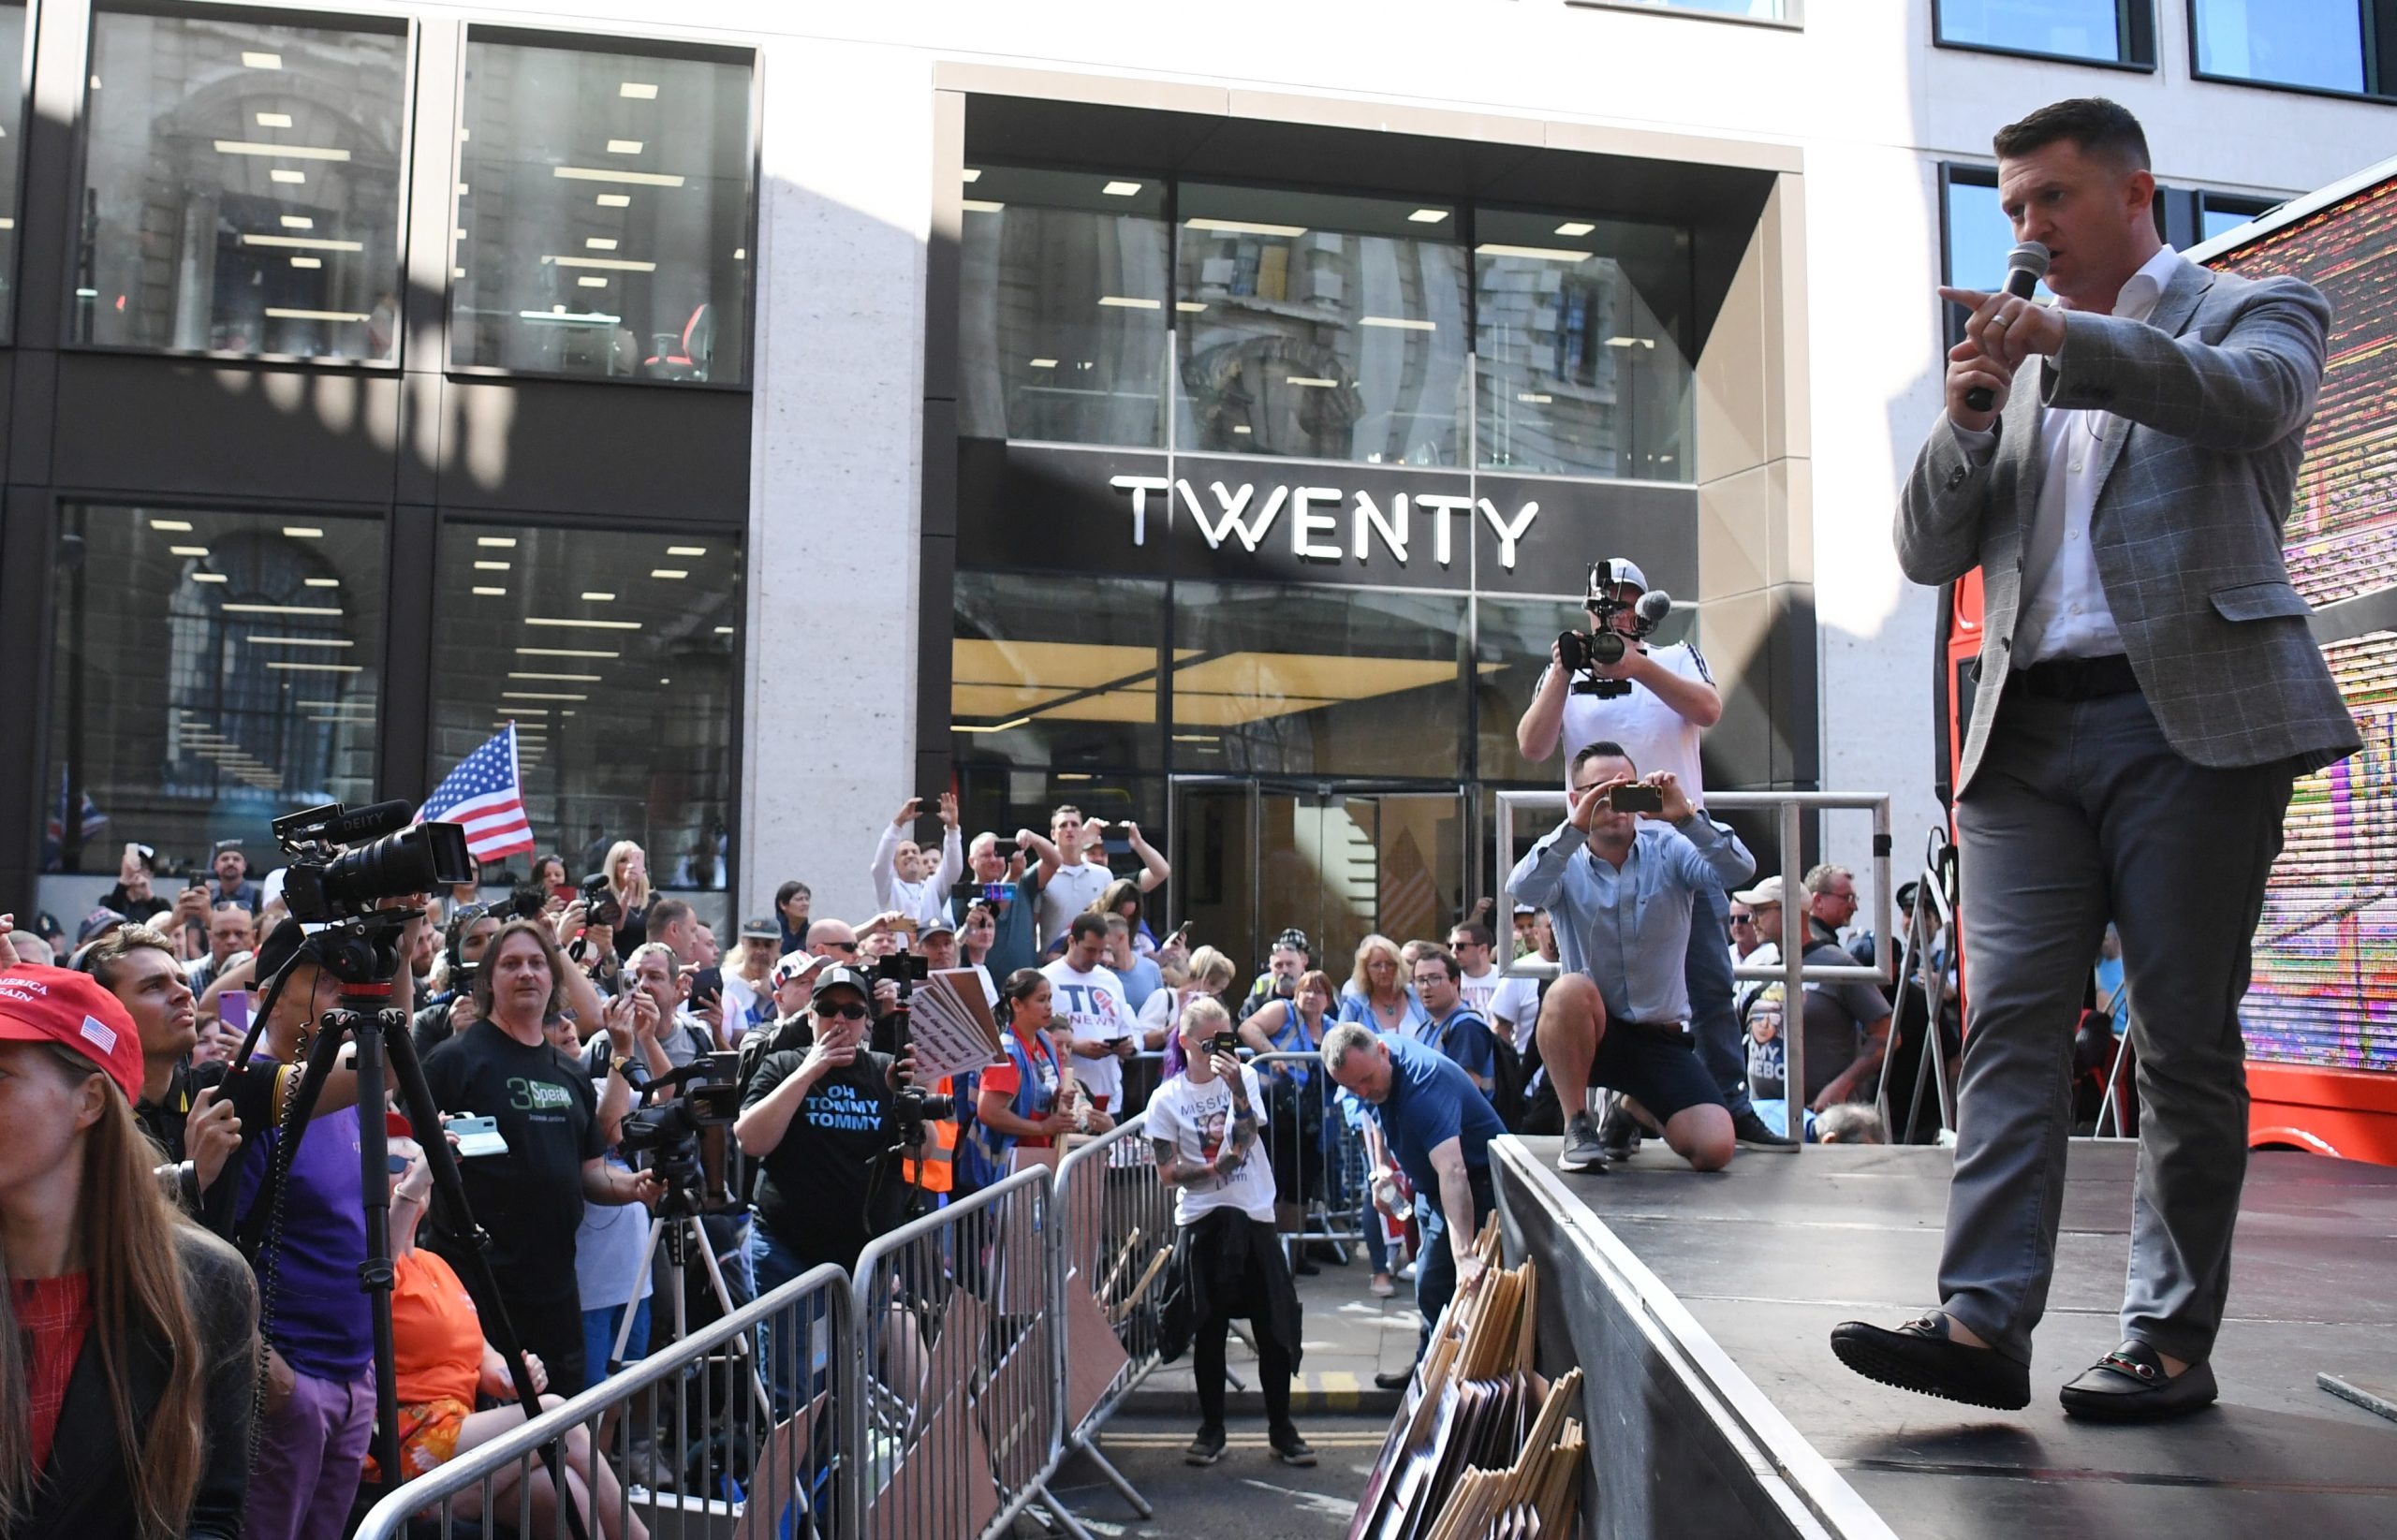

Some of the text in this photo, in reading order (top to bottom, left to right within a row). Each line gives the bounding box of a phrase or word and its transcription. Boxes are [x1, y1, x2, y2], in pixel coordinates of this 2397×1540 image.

[1109, 475, 1539, 568] TWENTY
[343, 812, 385, 832] DEITY
[828, 1085, 855, 1099] OH
[806, 1097, 878, 1114] TOMMY
[1181, 1090, 1232, 1117] MISSIN
[806, 1112, 881, 1131] TOMMY
